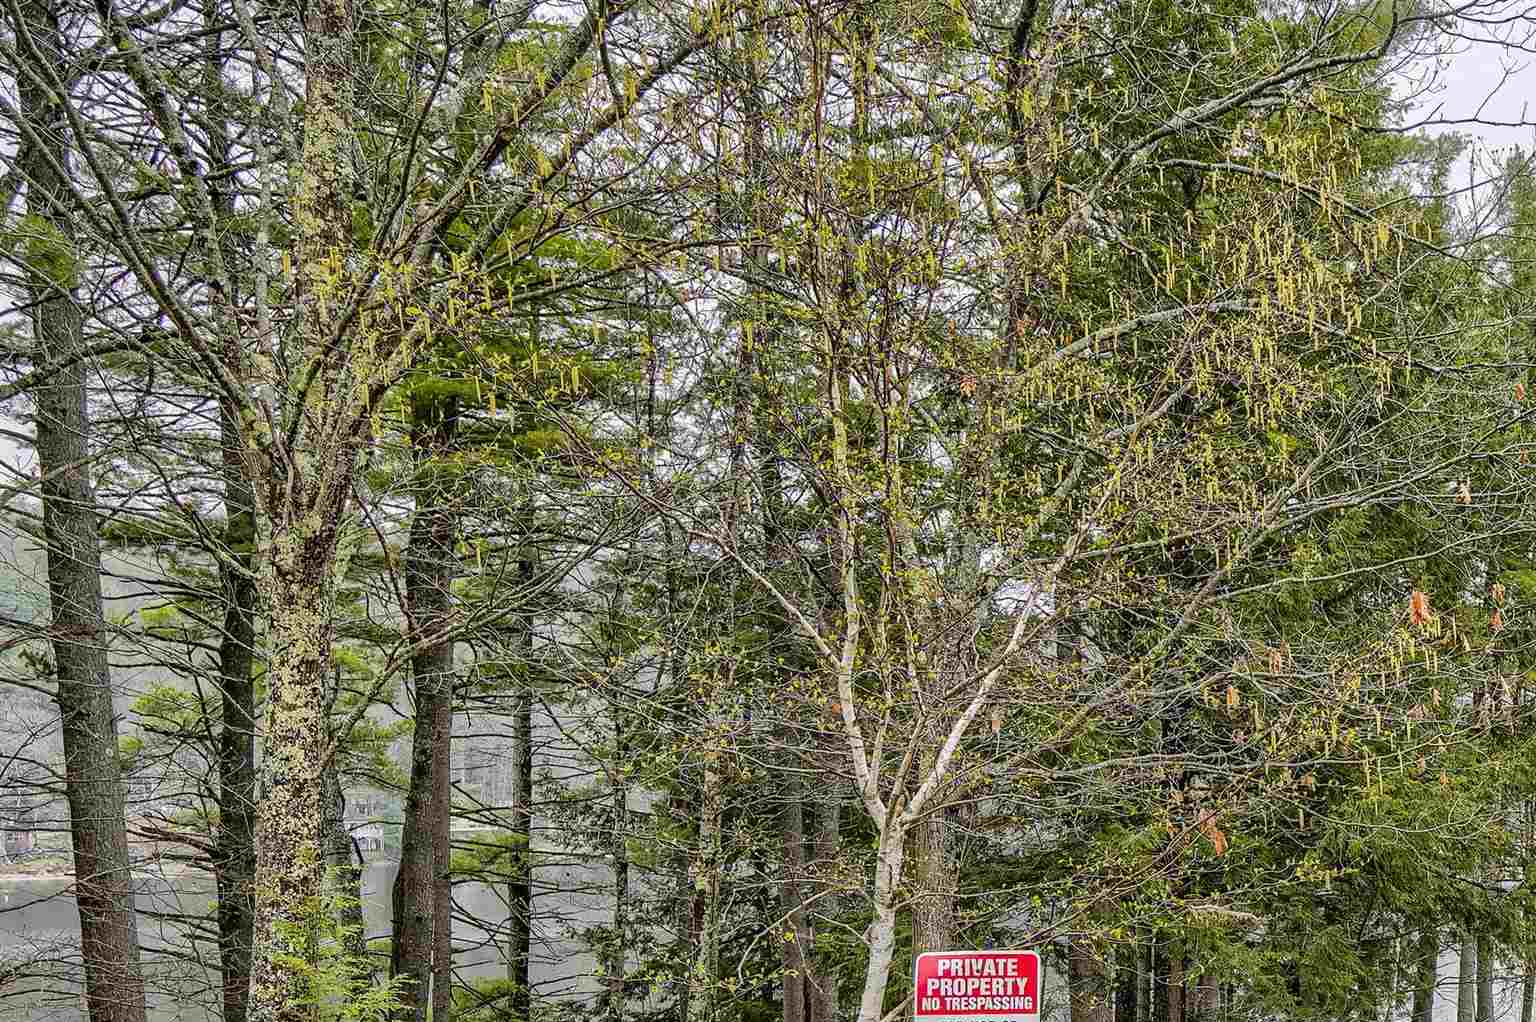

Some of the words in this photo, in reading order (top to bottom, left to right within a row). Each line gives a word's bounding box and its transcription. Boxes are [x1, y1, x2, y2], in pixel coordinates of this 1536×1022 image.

[938, 959, 1018, 976] PRIVATE
[927, 977, 1028, 996] PROPERTY
[922, 998, 940, 1011] NO
[945, 997, 1033, 1011] TRESPASSING
